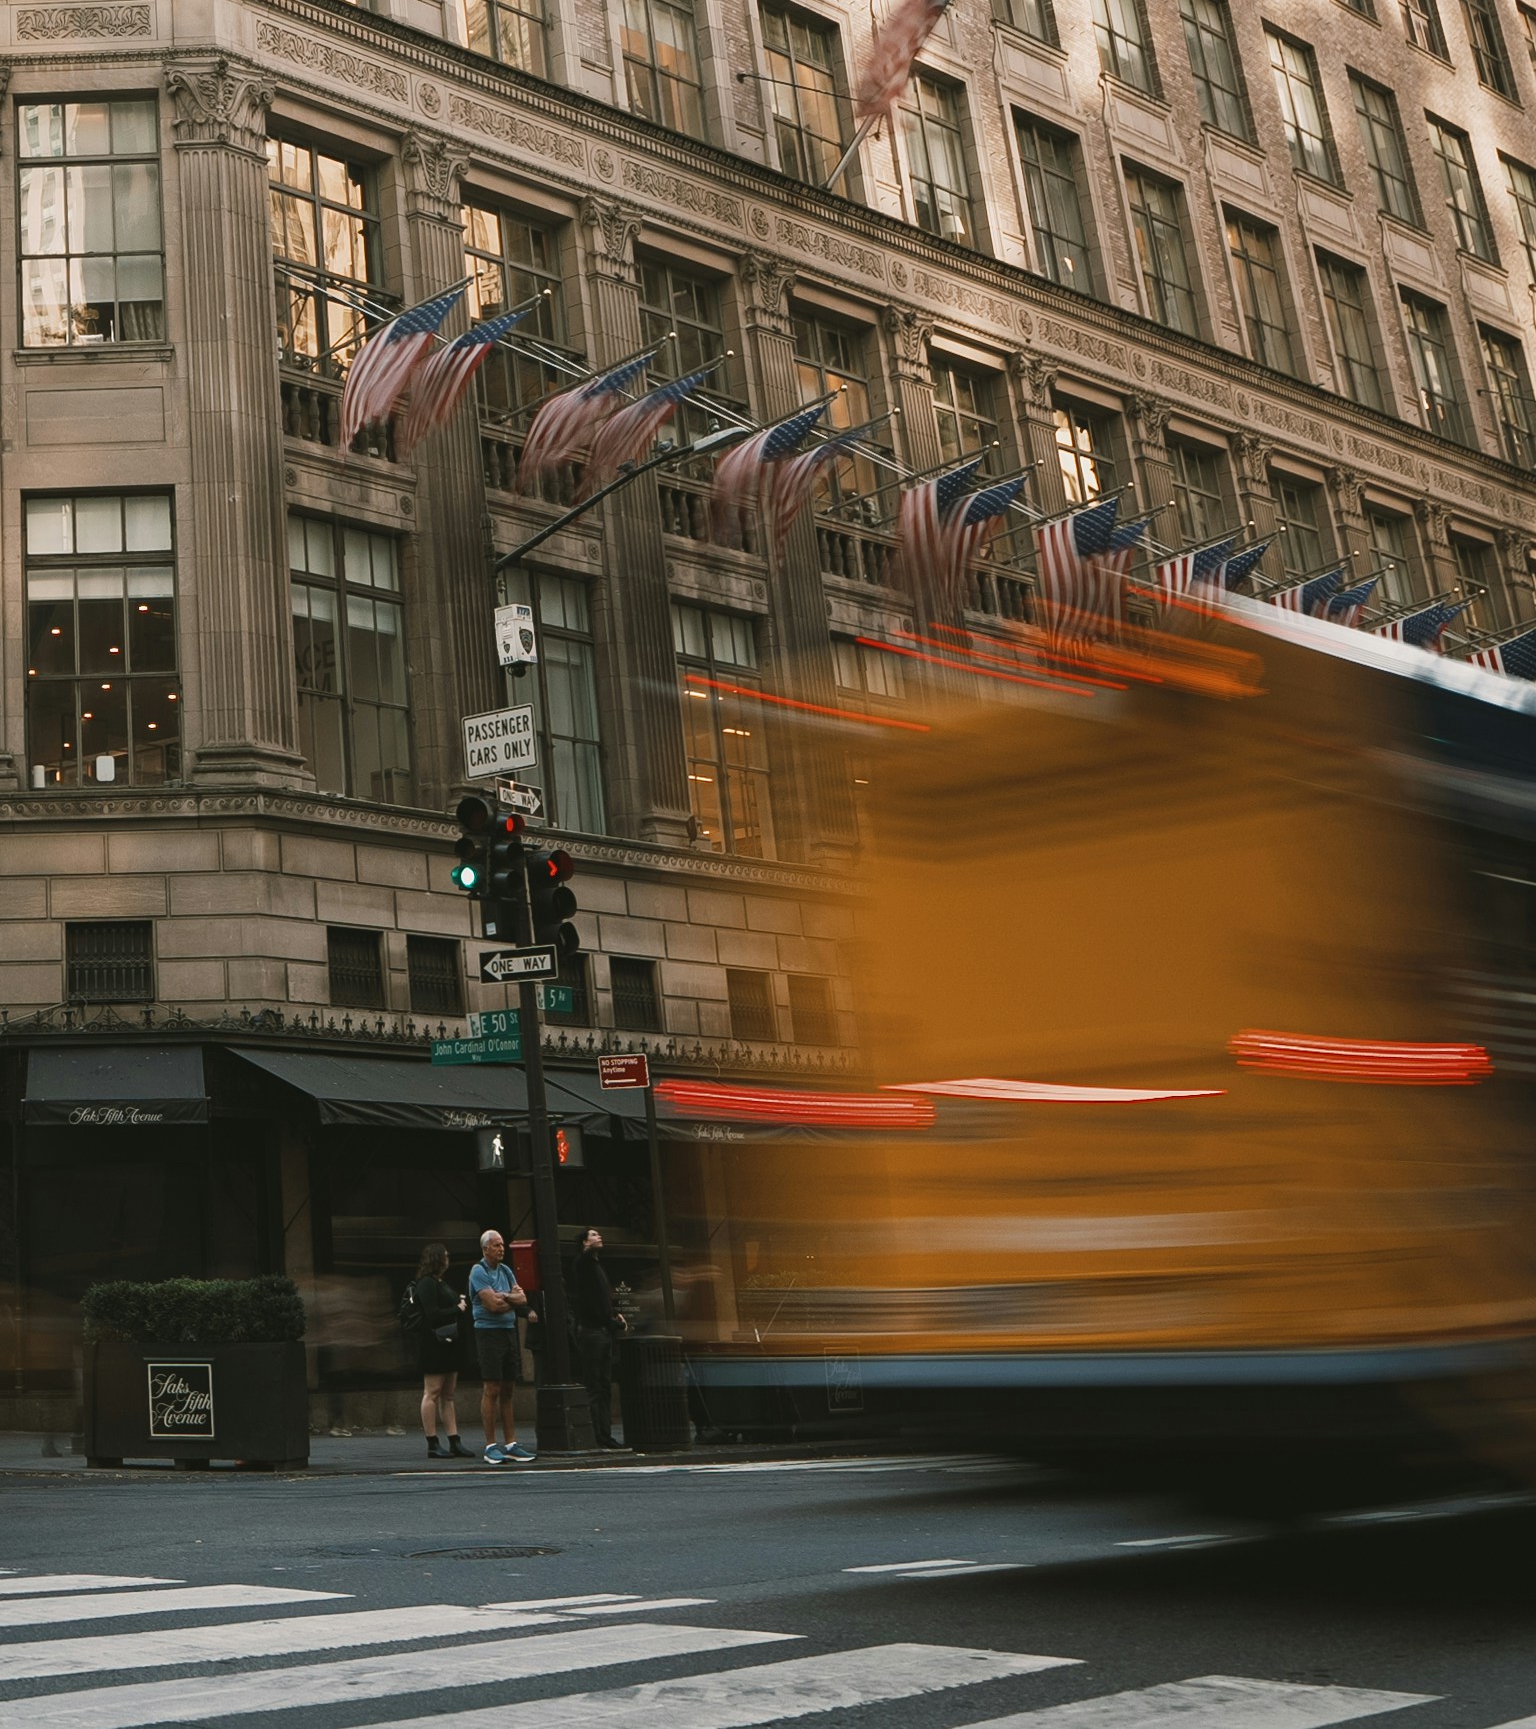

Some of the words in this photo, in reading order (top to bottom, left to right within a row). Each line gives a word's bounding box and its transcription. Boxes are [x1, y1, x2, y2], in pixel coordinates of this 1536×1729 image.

[468, 714, 530, 743] PASSENGER
[469, 745, 498, 767] CARS
[504, 738, 531, 760] ONLY
[502, 789, 516, 803] ONE
[521, 794, 536, 808] WAY
[491, 959, 514, 974] ONE
[523, 956, 546, 970] WAY
[550, 989, 556, 1008] 5
[480, 1015, 488, 1034] E
[491, 1013, 507, 1032] 50
[509, 1011, 518, 1024] St
[434, 1043, 453, 1056] John
[454, 1039, 486, 1055] Cardinal
[488, 1038, 520, 1053] O'Connor
[610, 1057, 639, 1066] STOPPING
[68, 1107, 100, 1125] Saks
[95, 1107, 125, 1126] Fifth
[122, 1106, 163, 1125] Avenue
[150, 1373, 190, 1399] Saks
[172, 1390, 212, 1414] Fifth
[151, 1402, 207, 1428] Avenue
